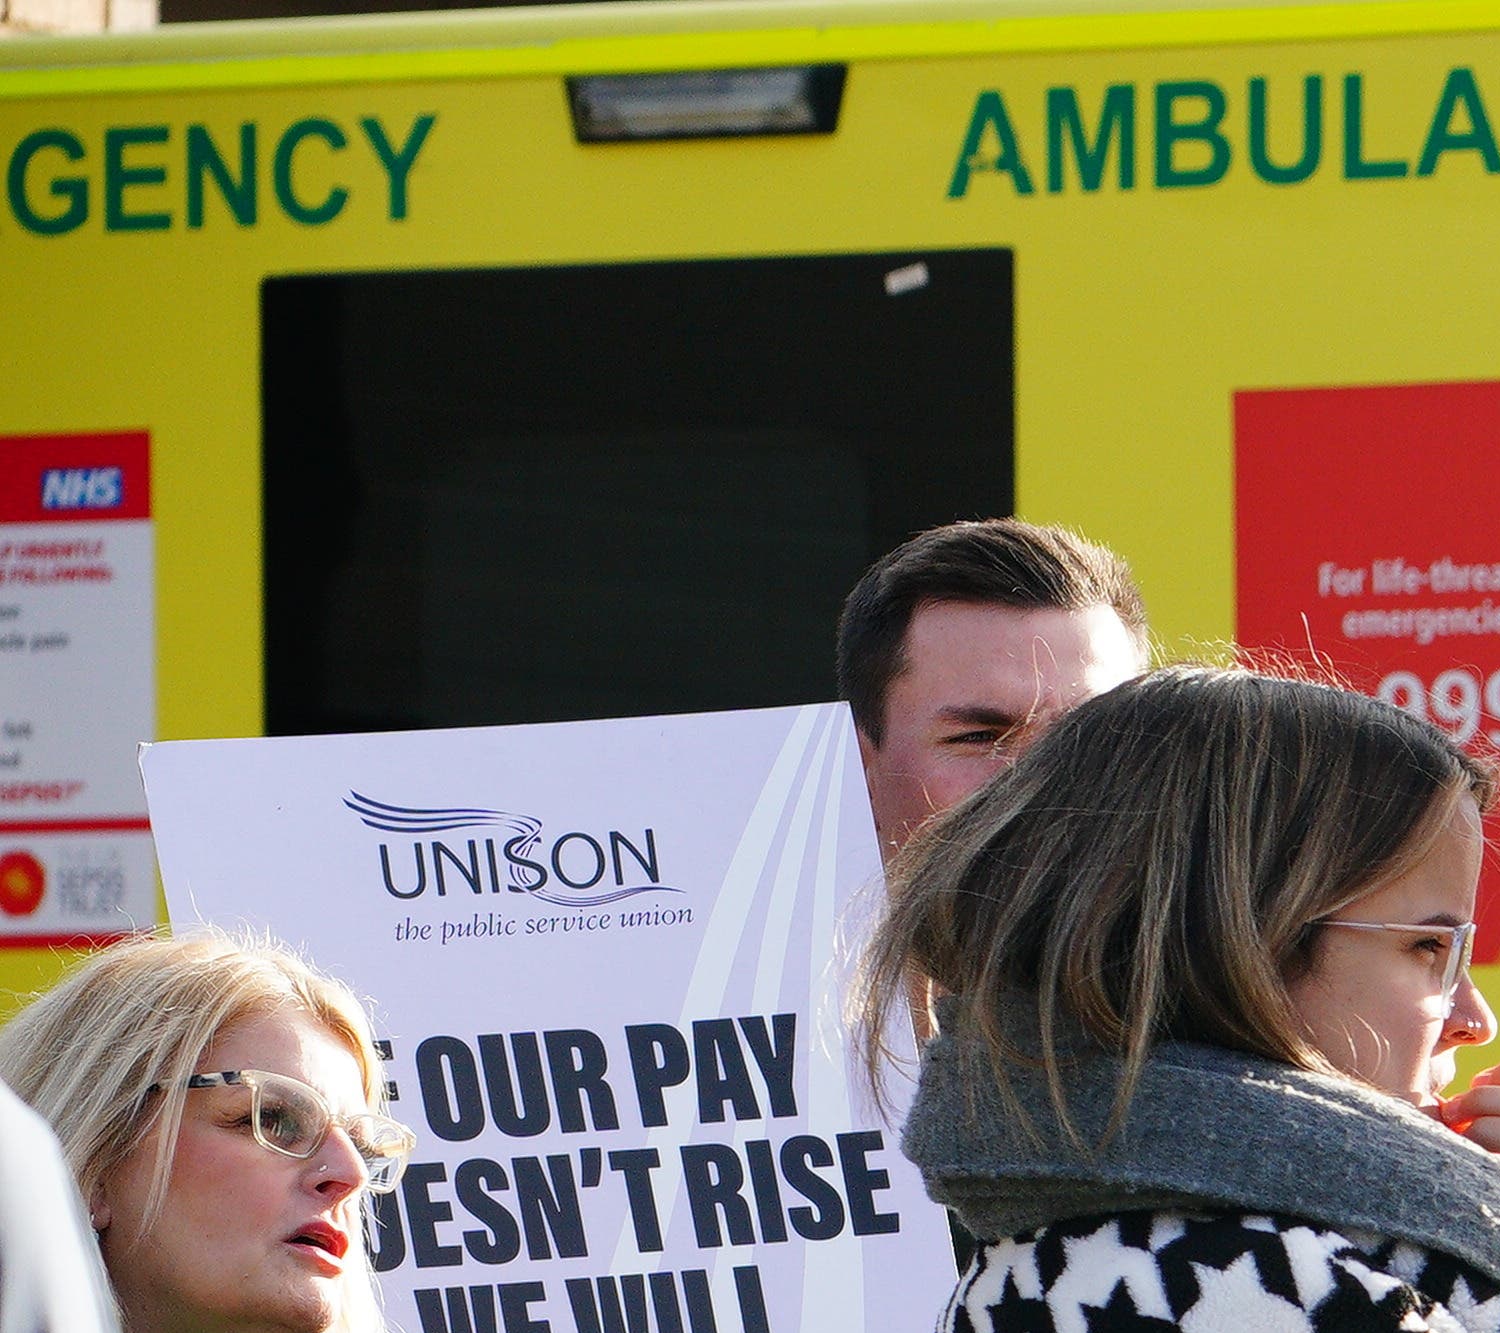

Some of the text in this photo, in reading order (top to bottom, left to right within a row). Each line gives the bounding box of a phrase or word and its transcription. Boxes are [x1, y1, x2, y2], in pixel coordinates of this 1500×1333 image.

[6, 114, 437, 236] GENCY
[44, 470, 121, 507] NHS
[1318, 561, 1366, 597] For
[379, 828, 660, 900] UNISON
[395, 904, 694, 945] the public service union
[415, 1029, 619, 1142] OUR
[625, 1013, 797, 1129] PAY
[680, 1130, 900, 1249] RISE
